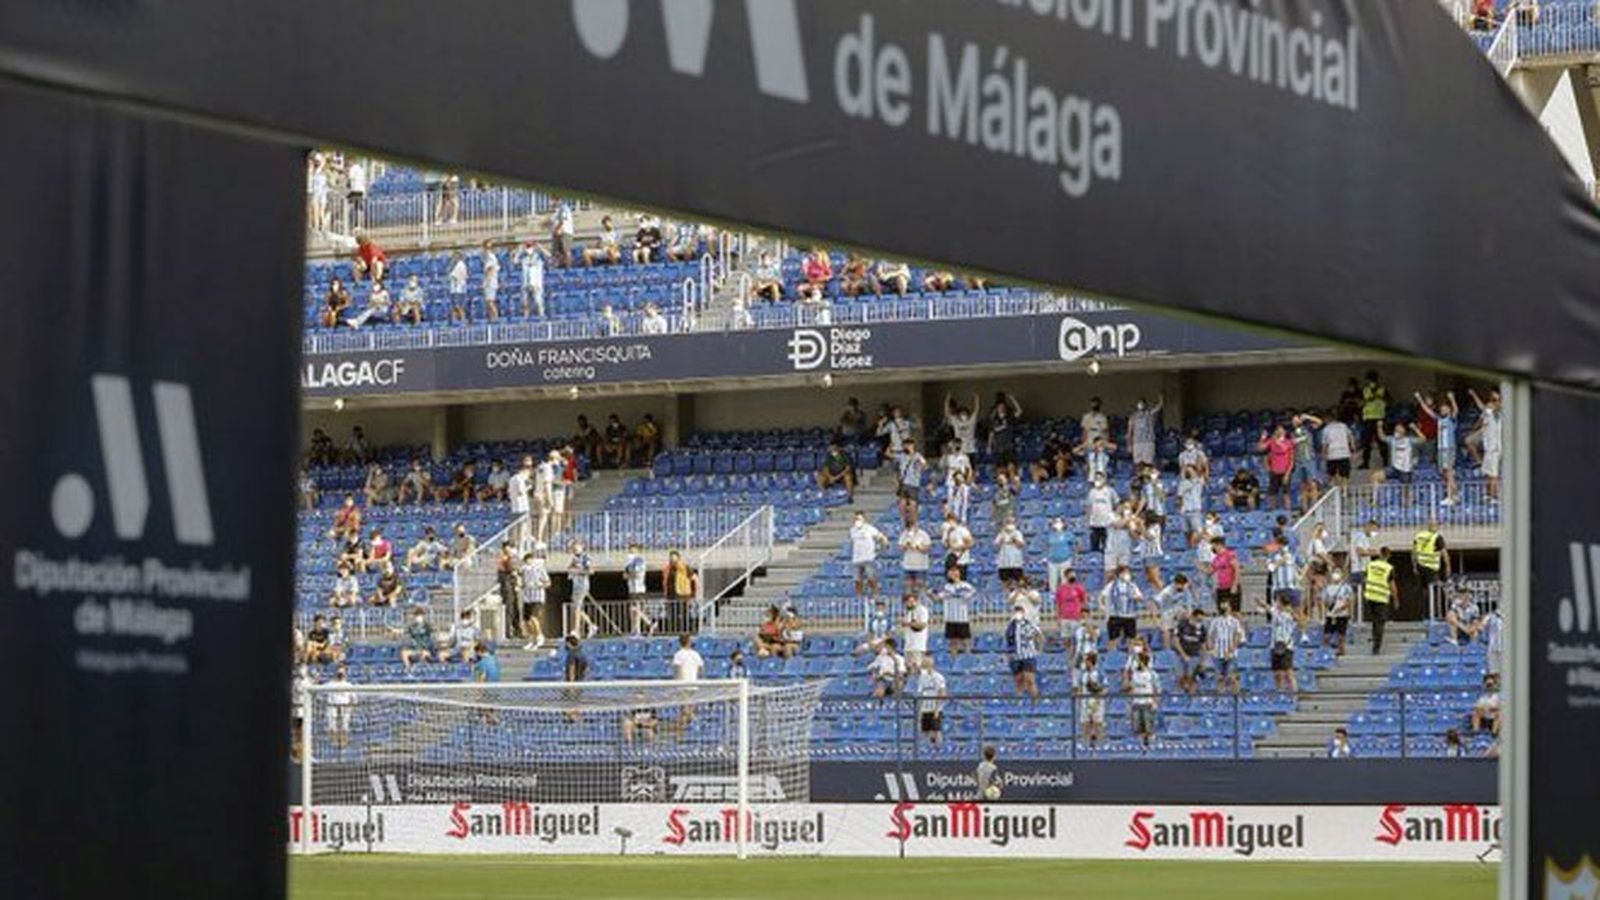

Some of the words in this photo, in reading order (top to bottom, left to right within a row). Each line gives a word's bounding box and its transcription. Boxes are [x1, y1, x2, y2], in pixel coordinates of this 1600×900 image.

[1146, 0, 1358, 110] Provincial
[833, 12, 912, 126] de
[926, 30, 1123, 197] Málaga
[831, 328, 871, 341] Diego
[487, 348, 534, 369] DOÑA
[538, 343, 651, 367] FRANCISQUITA
[1005, 772, 1074, 788] Provincial
